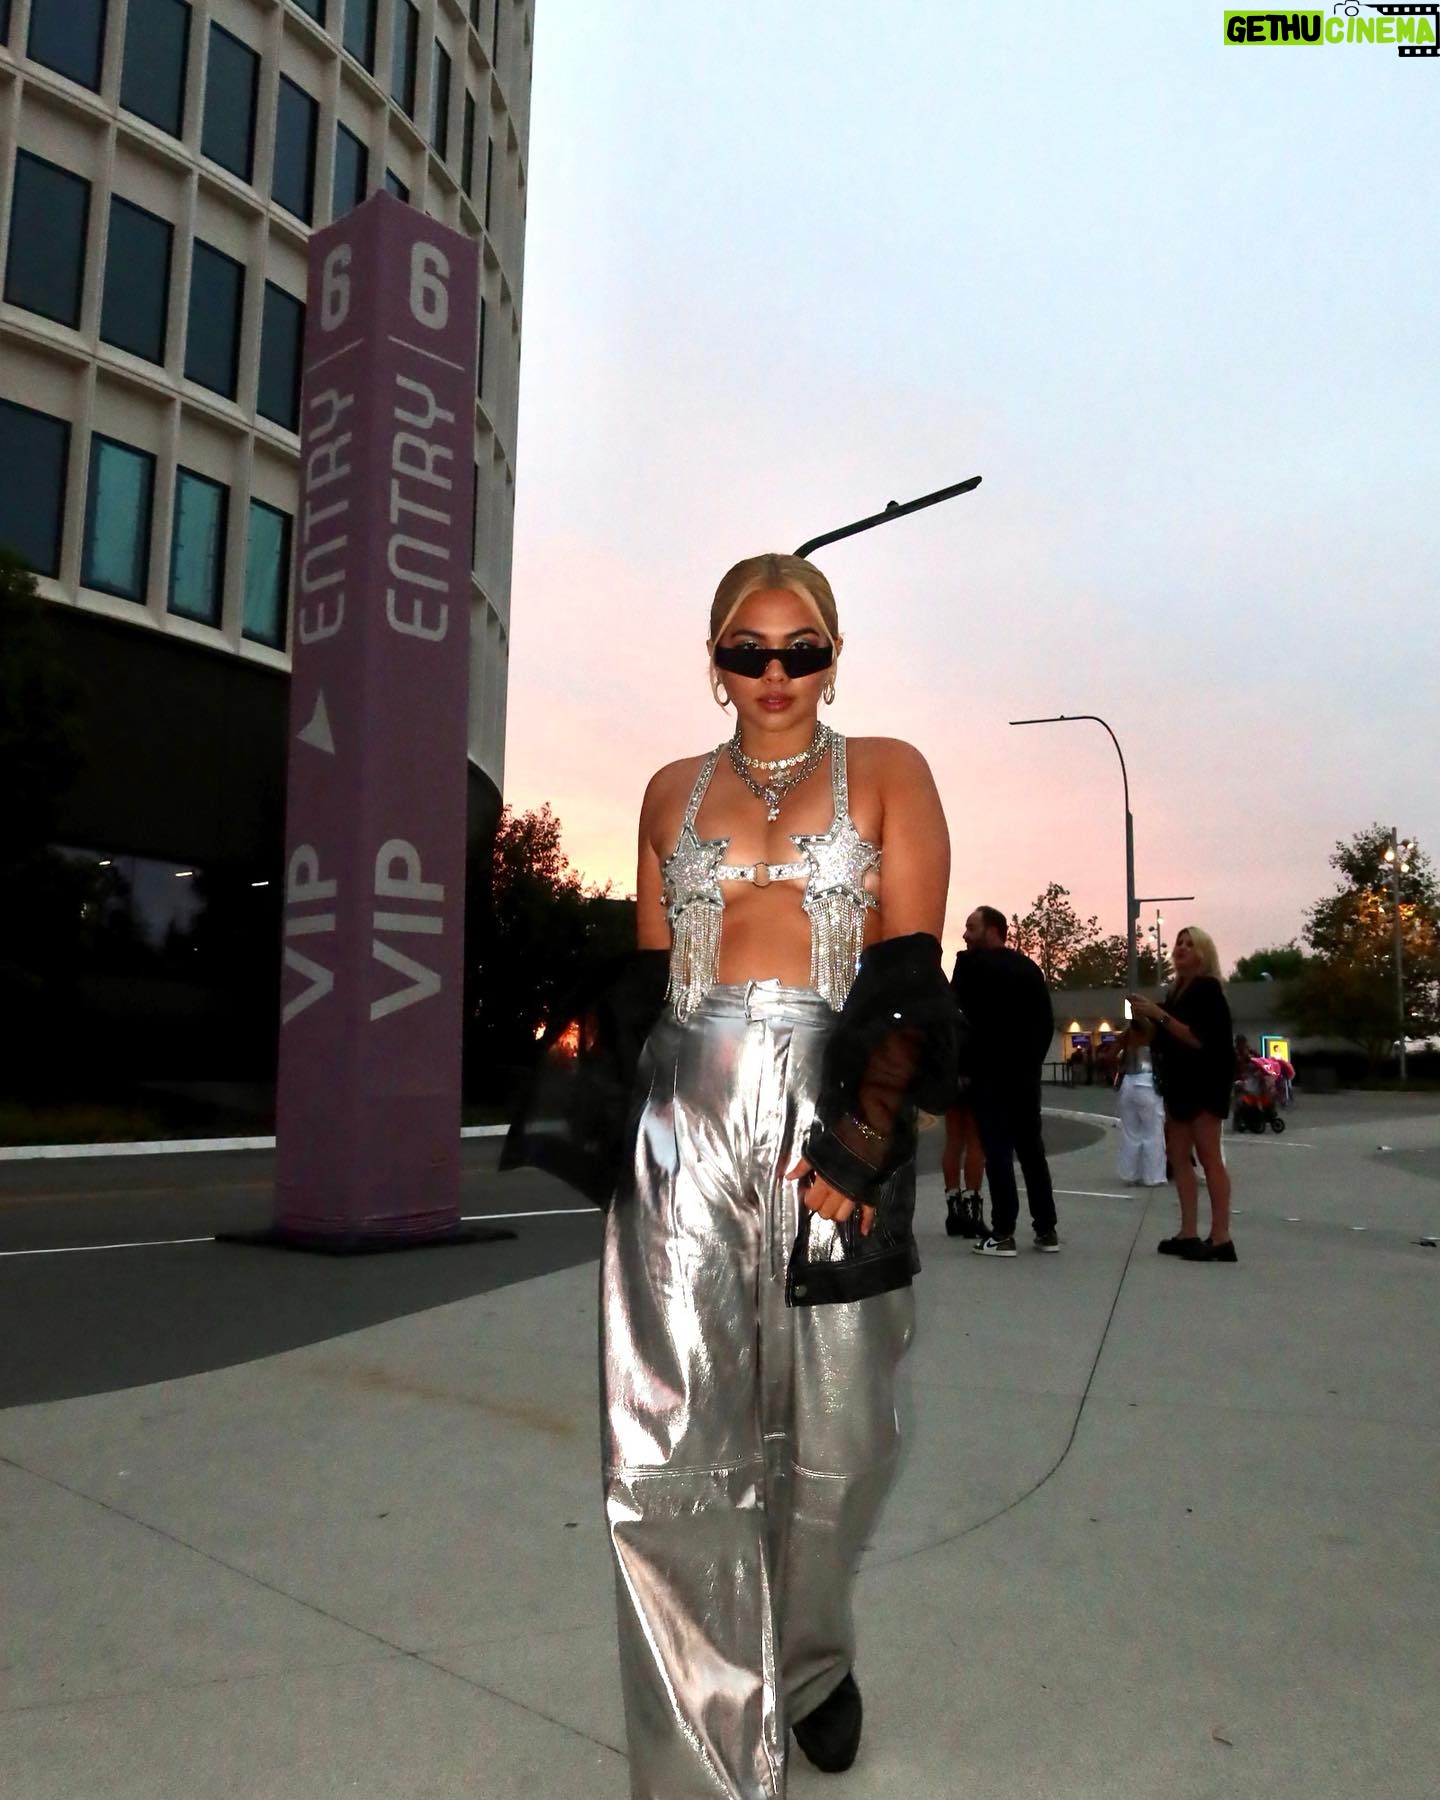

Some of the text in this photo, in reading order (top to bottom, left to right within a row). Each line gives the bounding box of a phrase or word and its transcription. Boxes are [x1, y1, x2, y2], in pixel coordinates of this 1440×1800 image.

[282, 243, 354, 1025] VIP ENTRY 6
[370, 241, 455, 1021] VIP ENTRY 6
